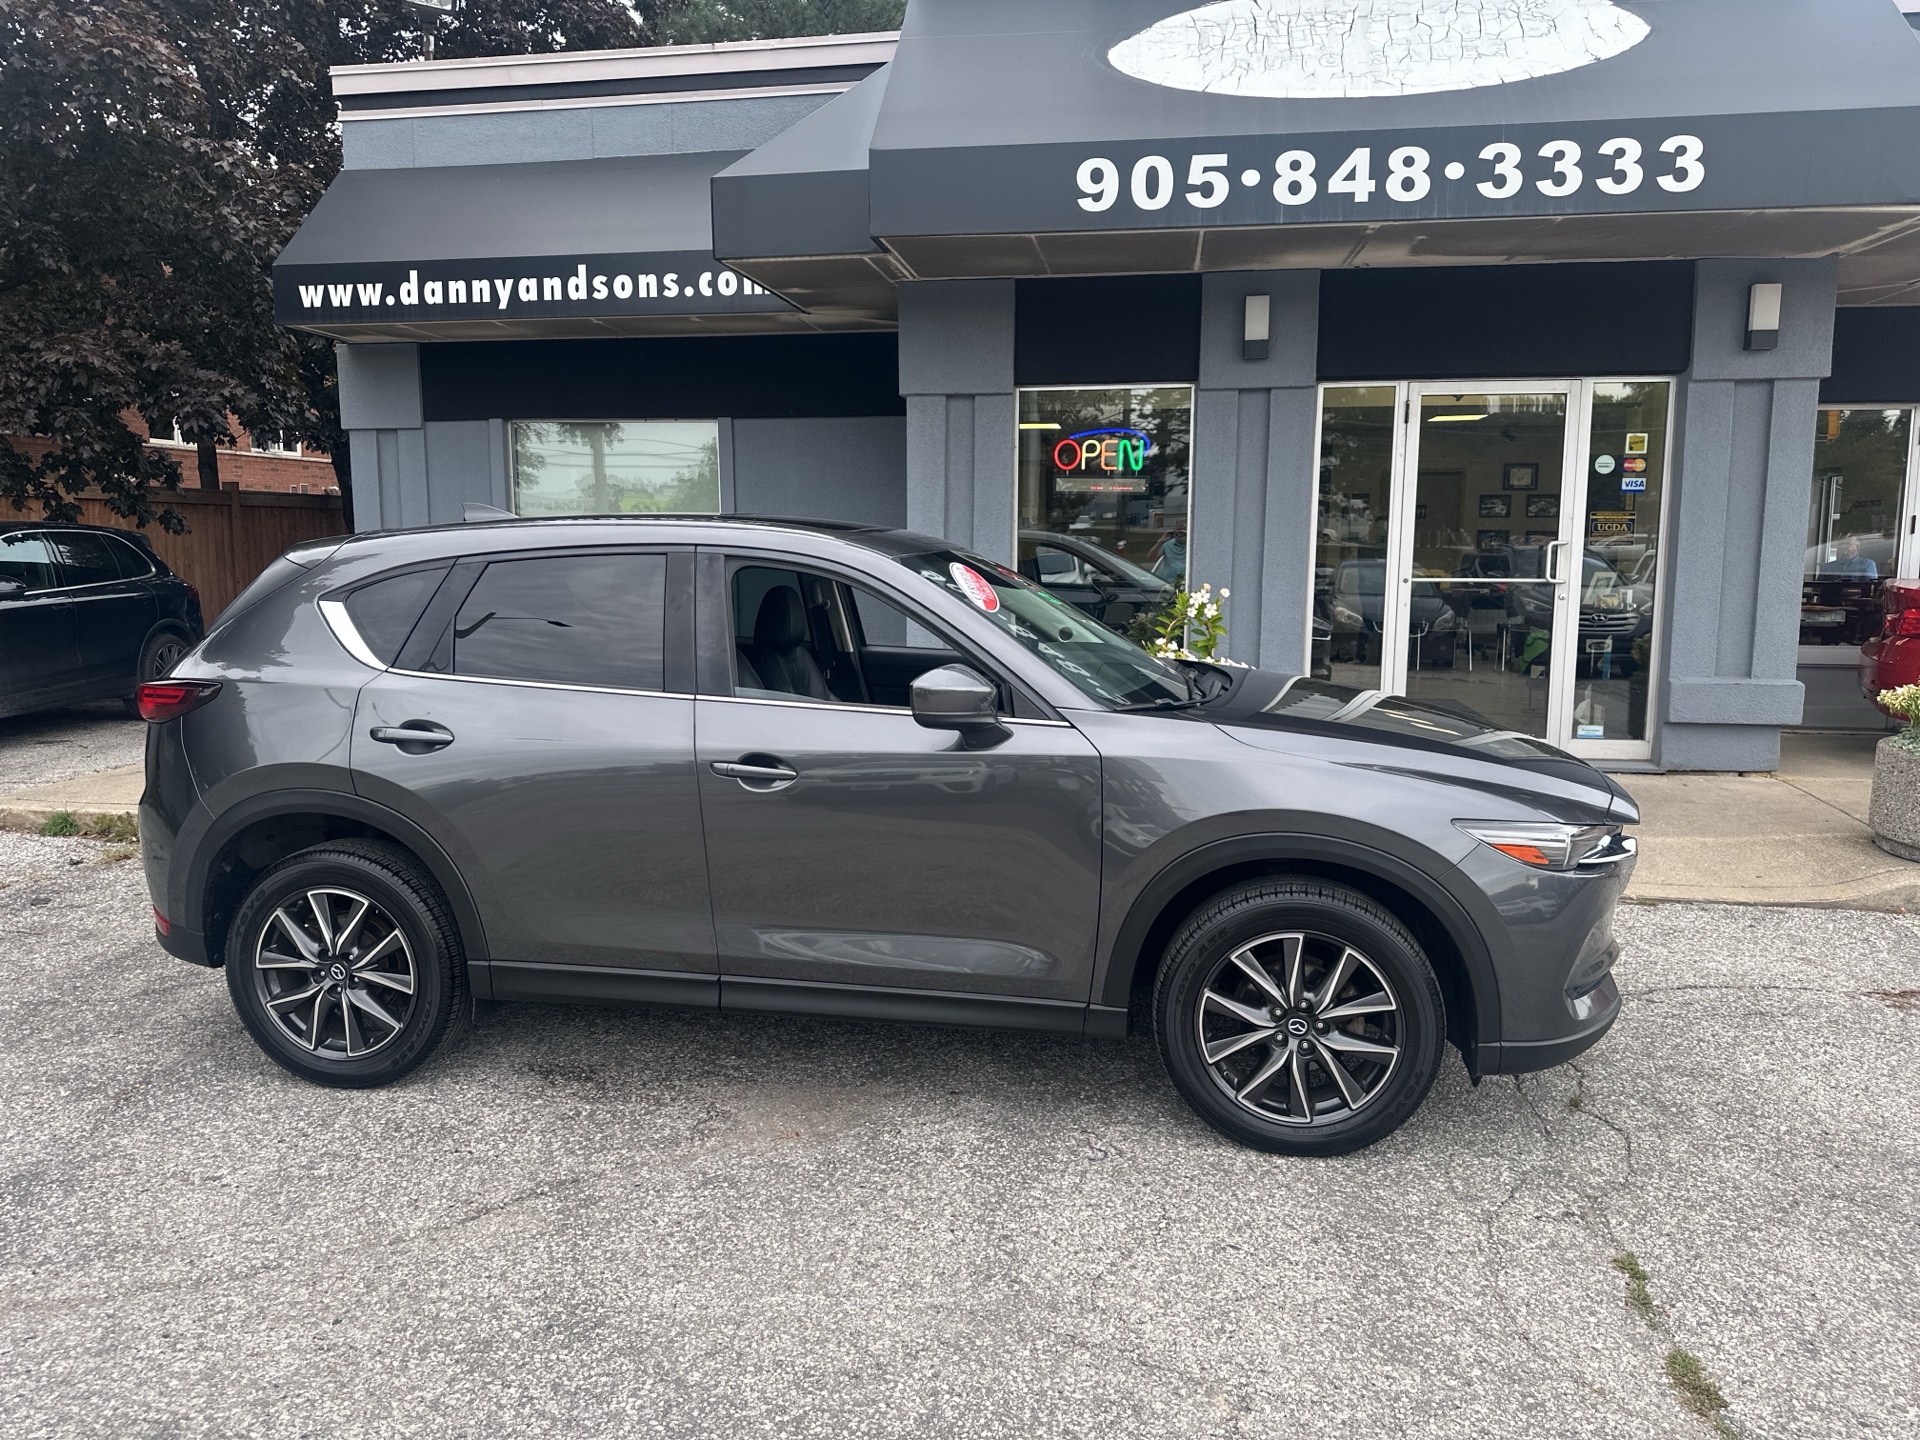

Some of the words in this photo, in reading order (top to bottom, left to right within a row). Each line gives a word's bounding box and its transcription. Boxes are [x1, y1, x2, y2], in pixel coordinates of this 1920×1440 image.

[1053, 438, 1144, 471] OPEN
[1624, 480, 1645, 488] VISA
[1596, 523, 1629, 532] UCDA
